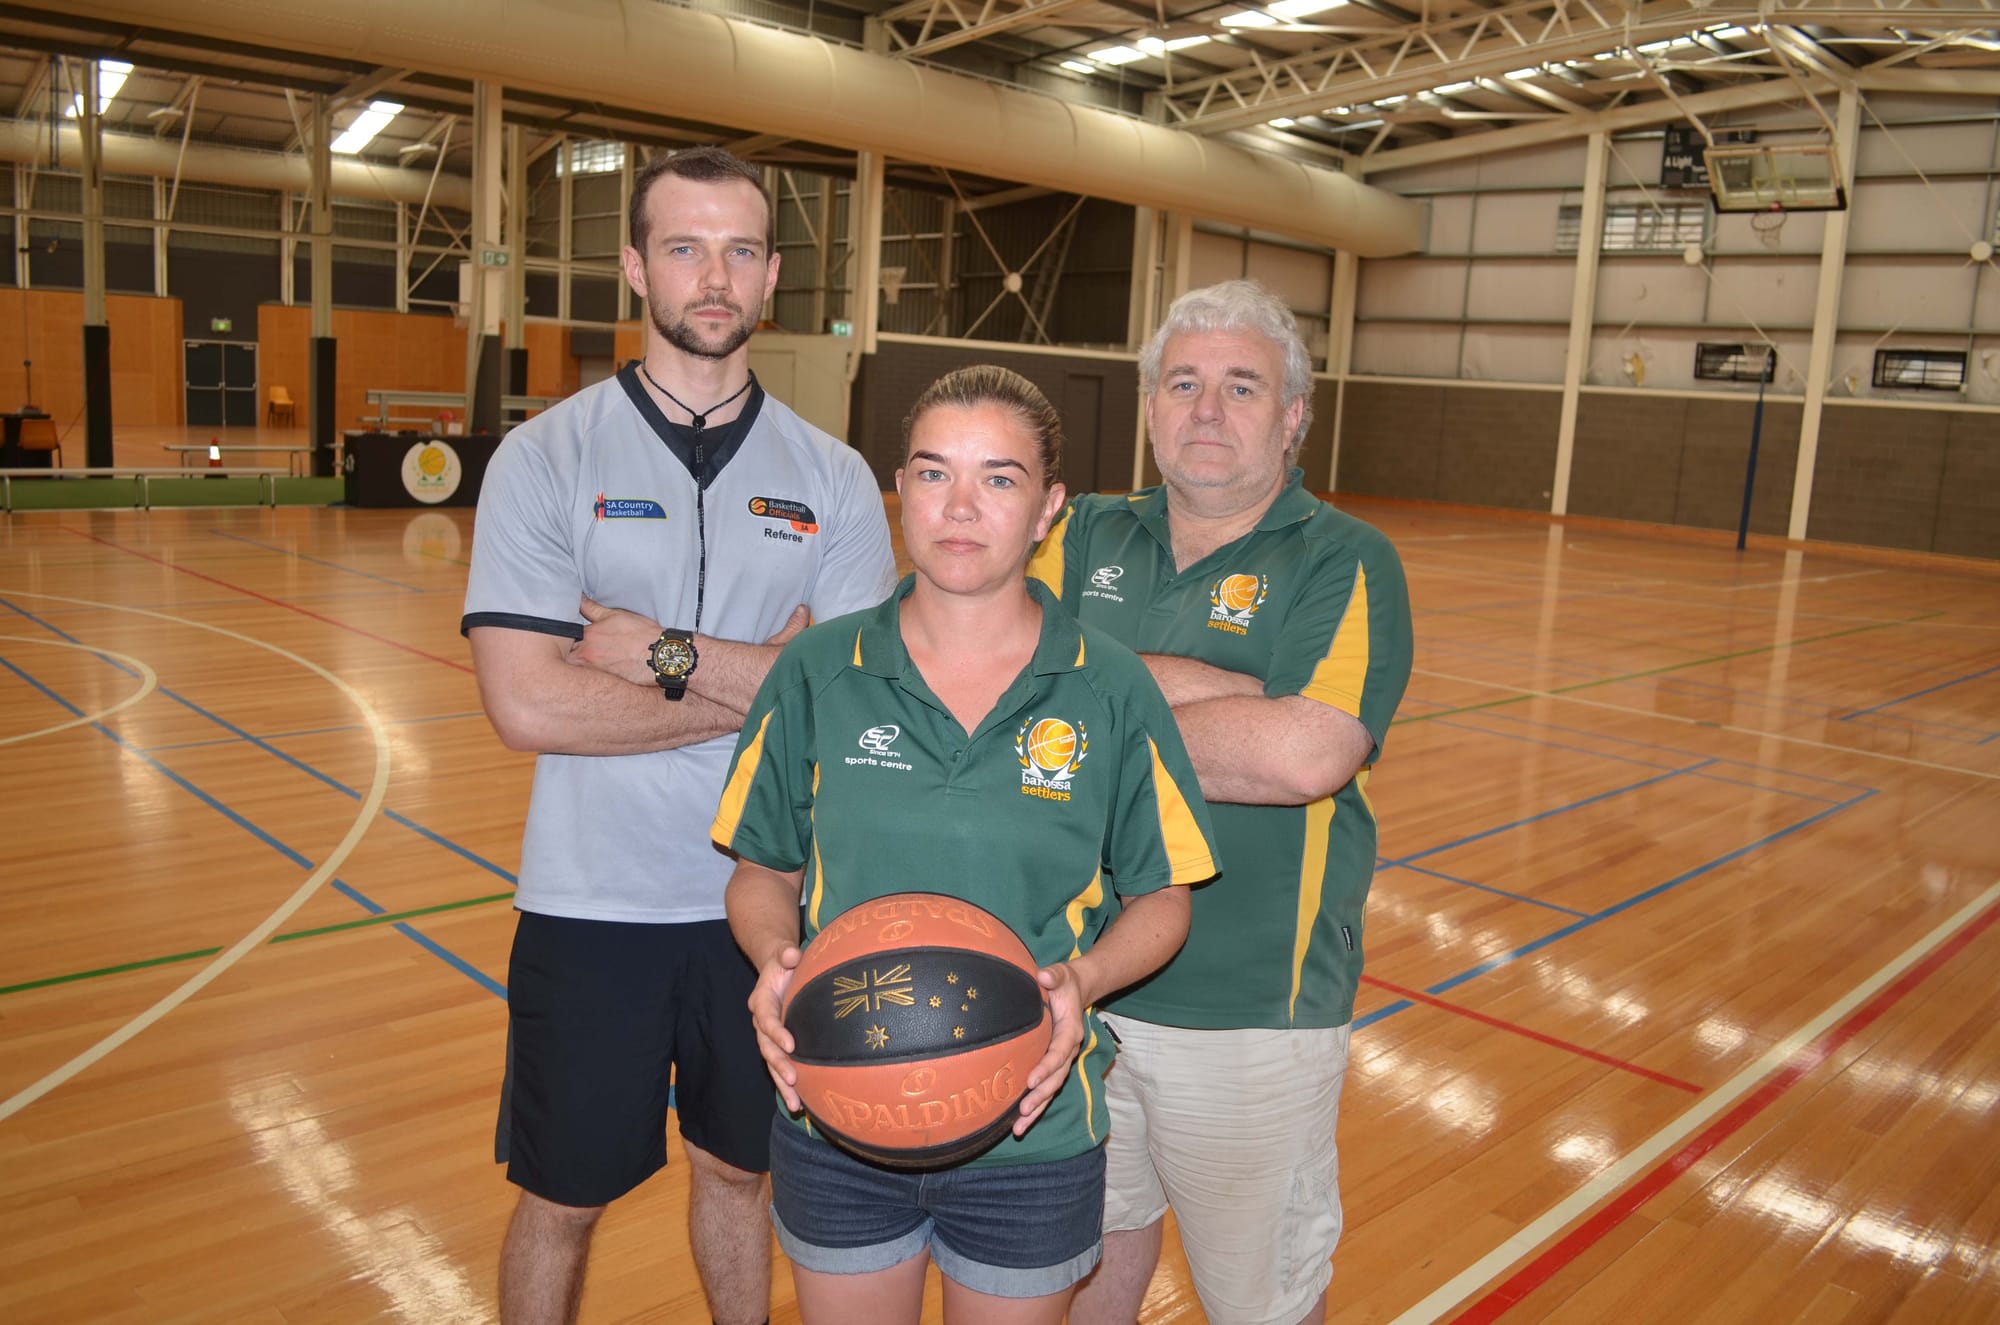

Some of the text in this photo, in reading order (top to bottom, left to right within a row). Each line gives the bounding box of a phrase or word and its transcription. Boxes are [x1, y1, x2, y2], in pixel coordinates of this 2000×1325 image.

[606, 501, 654, 511] SA Country
[768, 501, 807, 513] Basketball
[768, 509, 801, 520] Officials
[764, 528, 804, 543] Referee
[1100, 592, 1124, 602] centre
[1210, 609, 1250, 627] barossa
[1207, 620, 1248, 636] settlers
[845, 757, 913, 771] sports centre
[1021, 771, 1072, 791] barossa
[1021, 785, 1072, 802] settlers
[823, 1060, 1018, 1130] SPALDING
